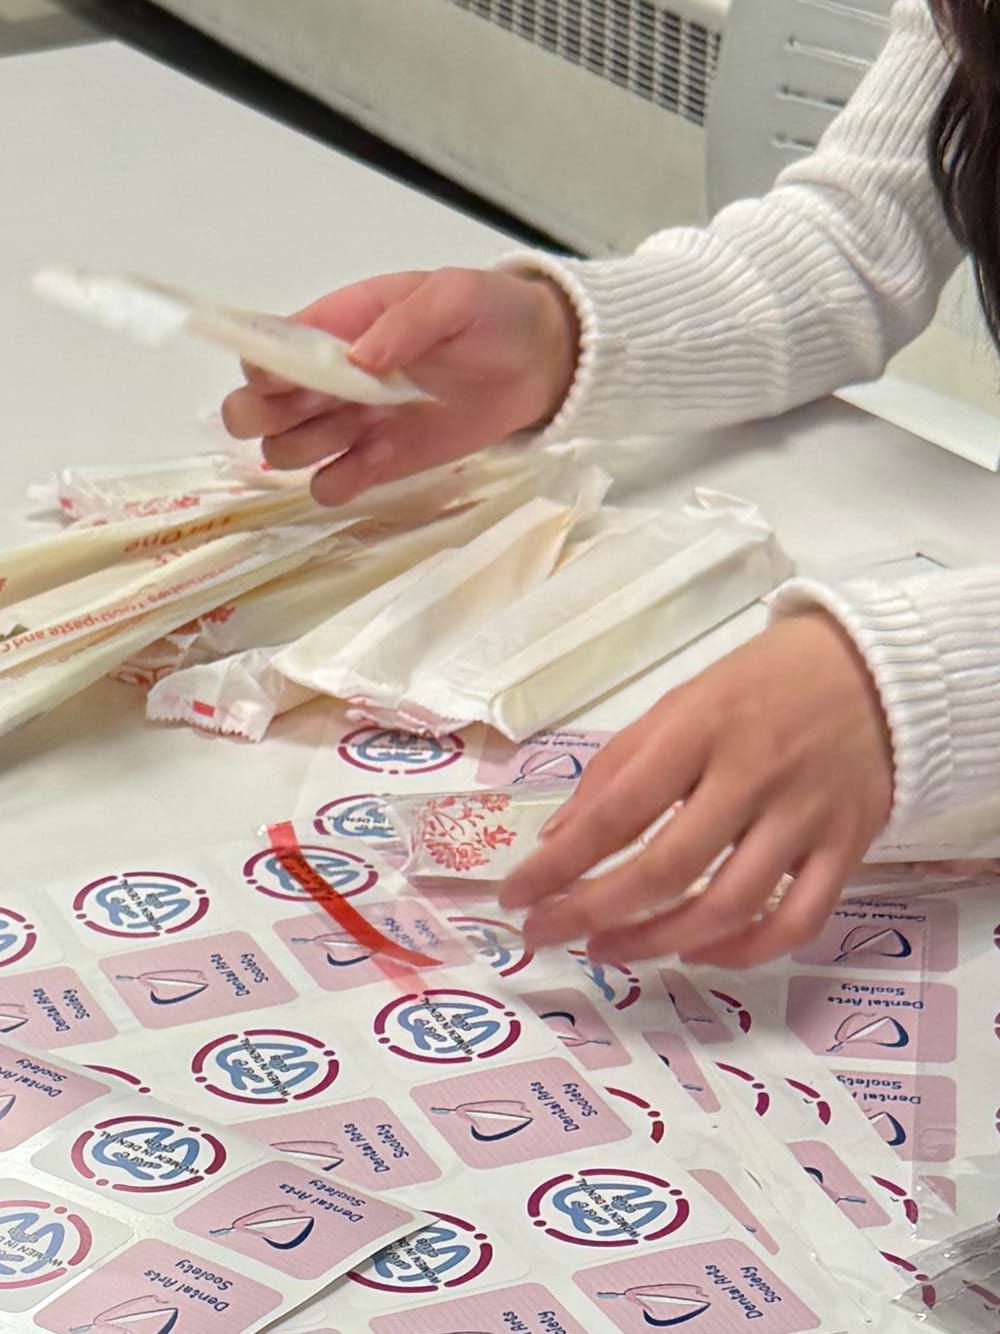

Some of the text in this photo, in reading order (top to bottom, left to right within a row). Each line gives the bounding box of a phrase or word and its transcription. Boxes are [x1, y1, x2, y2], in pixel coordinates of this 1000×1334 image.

[529, 1081, 580, 1132] Dental Arts
[562, 1082, 598, 1117] Society
[862, 1092, 921, 1104] Dental
[343, 1122, 390, 1173] Dental Arts
[375, 1123, 409, 1158] Society
[278, 1183, 363, 1222] Dental Arts
[307, 1179, 366, 1206] Society
[575, 1177, 606, 1203] DENTAL
[607, 1211, 641, 1238] WOMEN
[143, 1269, 230, 1312] Dental Arts
[174, 1258, 233, 1291] Society
[704, 1264, 763, 1319] Dental Arts
[739, 1265, 782, 1303] Society
[502, 1310, 528, 1331] Arts
